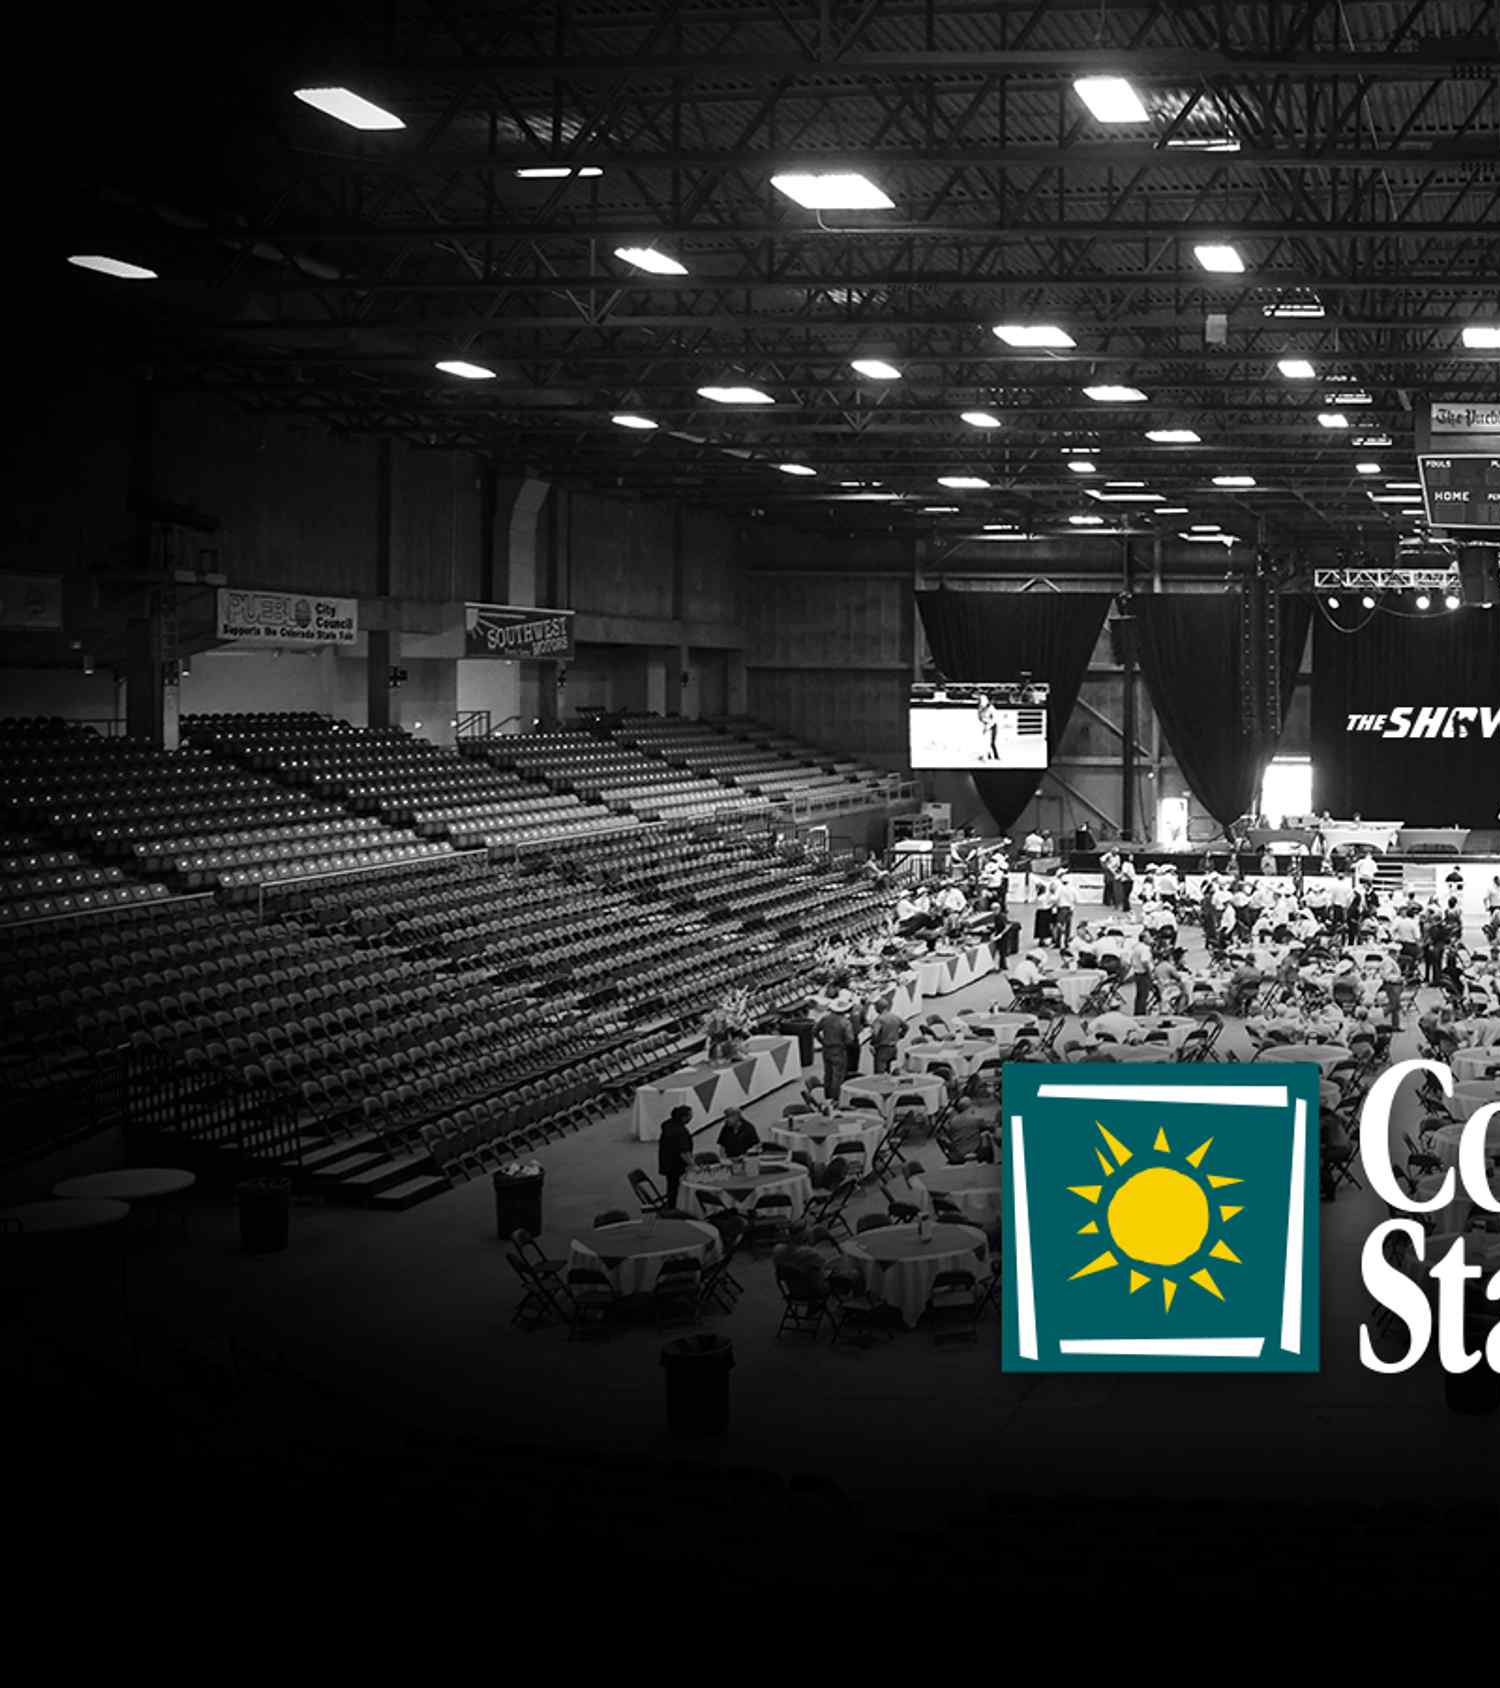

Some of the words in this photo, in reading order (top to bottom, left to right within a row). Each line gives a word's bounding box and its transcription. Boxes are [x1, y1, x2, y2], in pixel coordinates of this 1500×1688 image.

[1435, 408, 1462, 427] The
[1425, 460, 1451, 469] FOULS
[1434, 491, 1470, 501] HOME
[315, 602, 335, 618] City
[315, 616, 353, 630] Council
[487, 615, 568, 650] SOUTHWEST
[1346, 714, 1388, 731] THE
